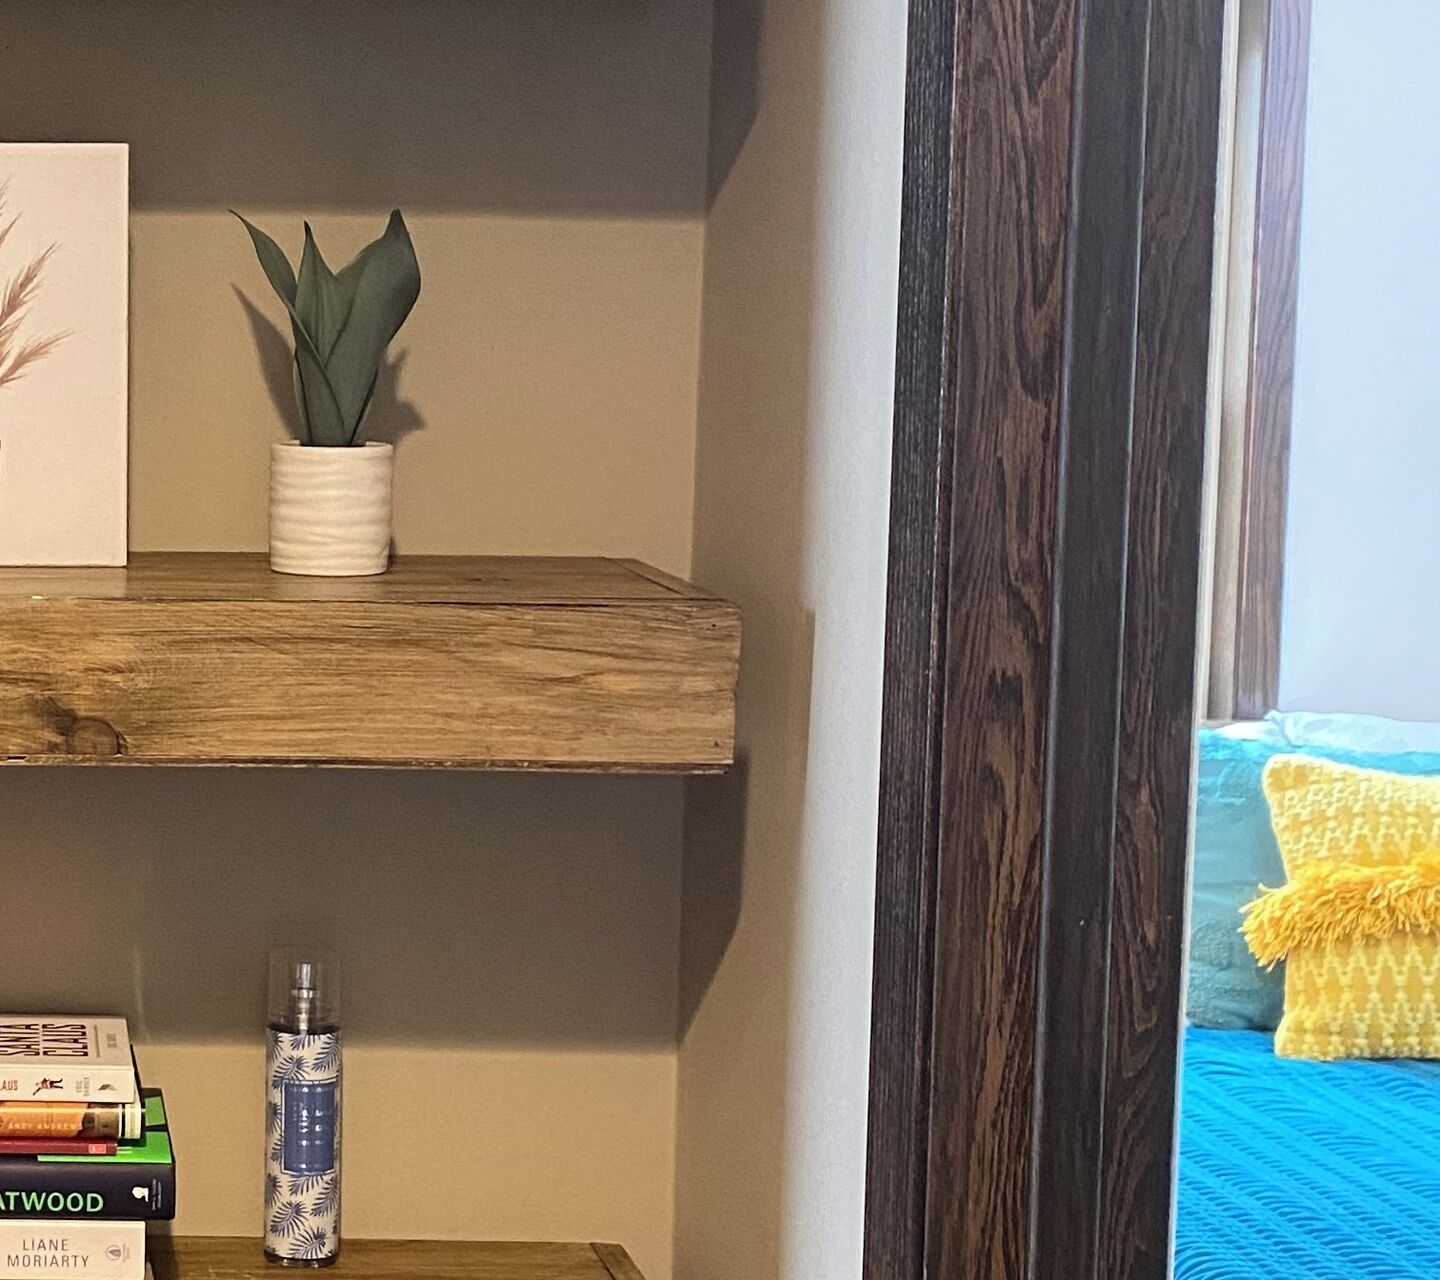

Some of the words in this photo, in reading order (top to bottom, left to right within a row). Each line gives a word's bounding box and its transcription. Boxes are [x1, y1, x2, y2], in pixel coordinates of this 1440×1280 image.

[41, 1023, 89, 1057] CLAUS
[22, 1238, 69, 1251] LIANE
[7, 1254, 90, 1268] MORIARTY
